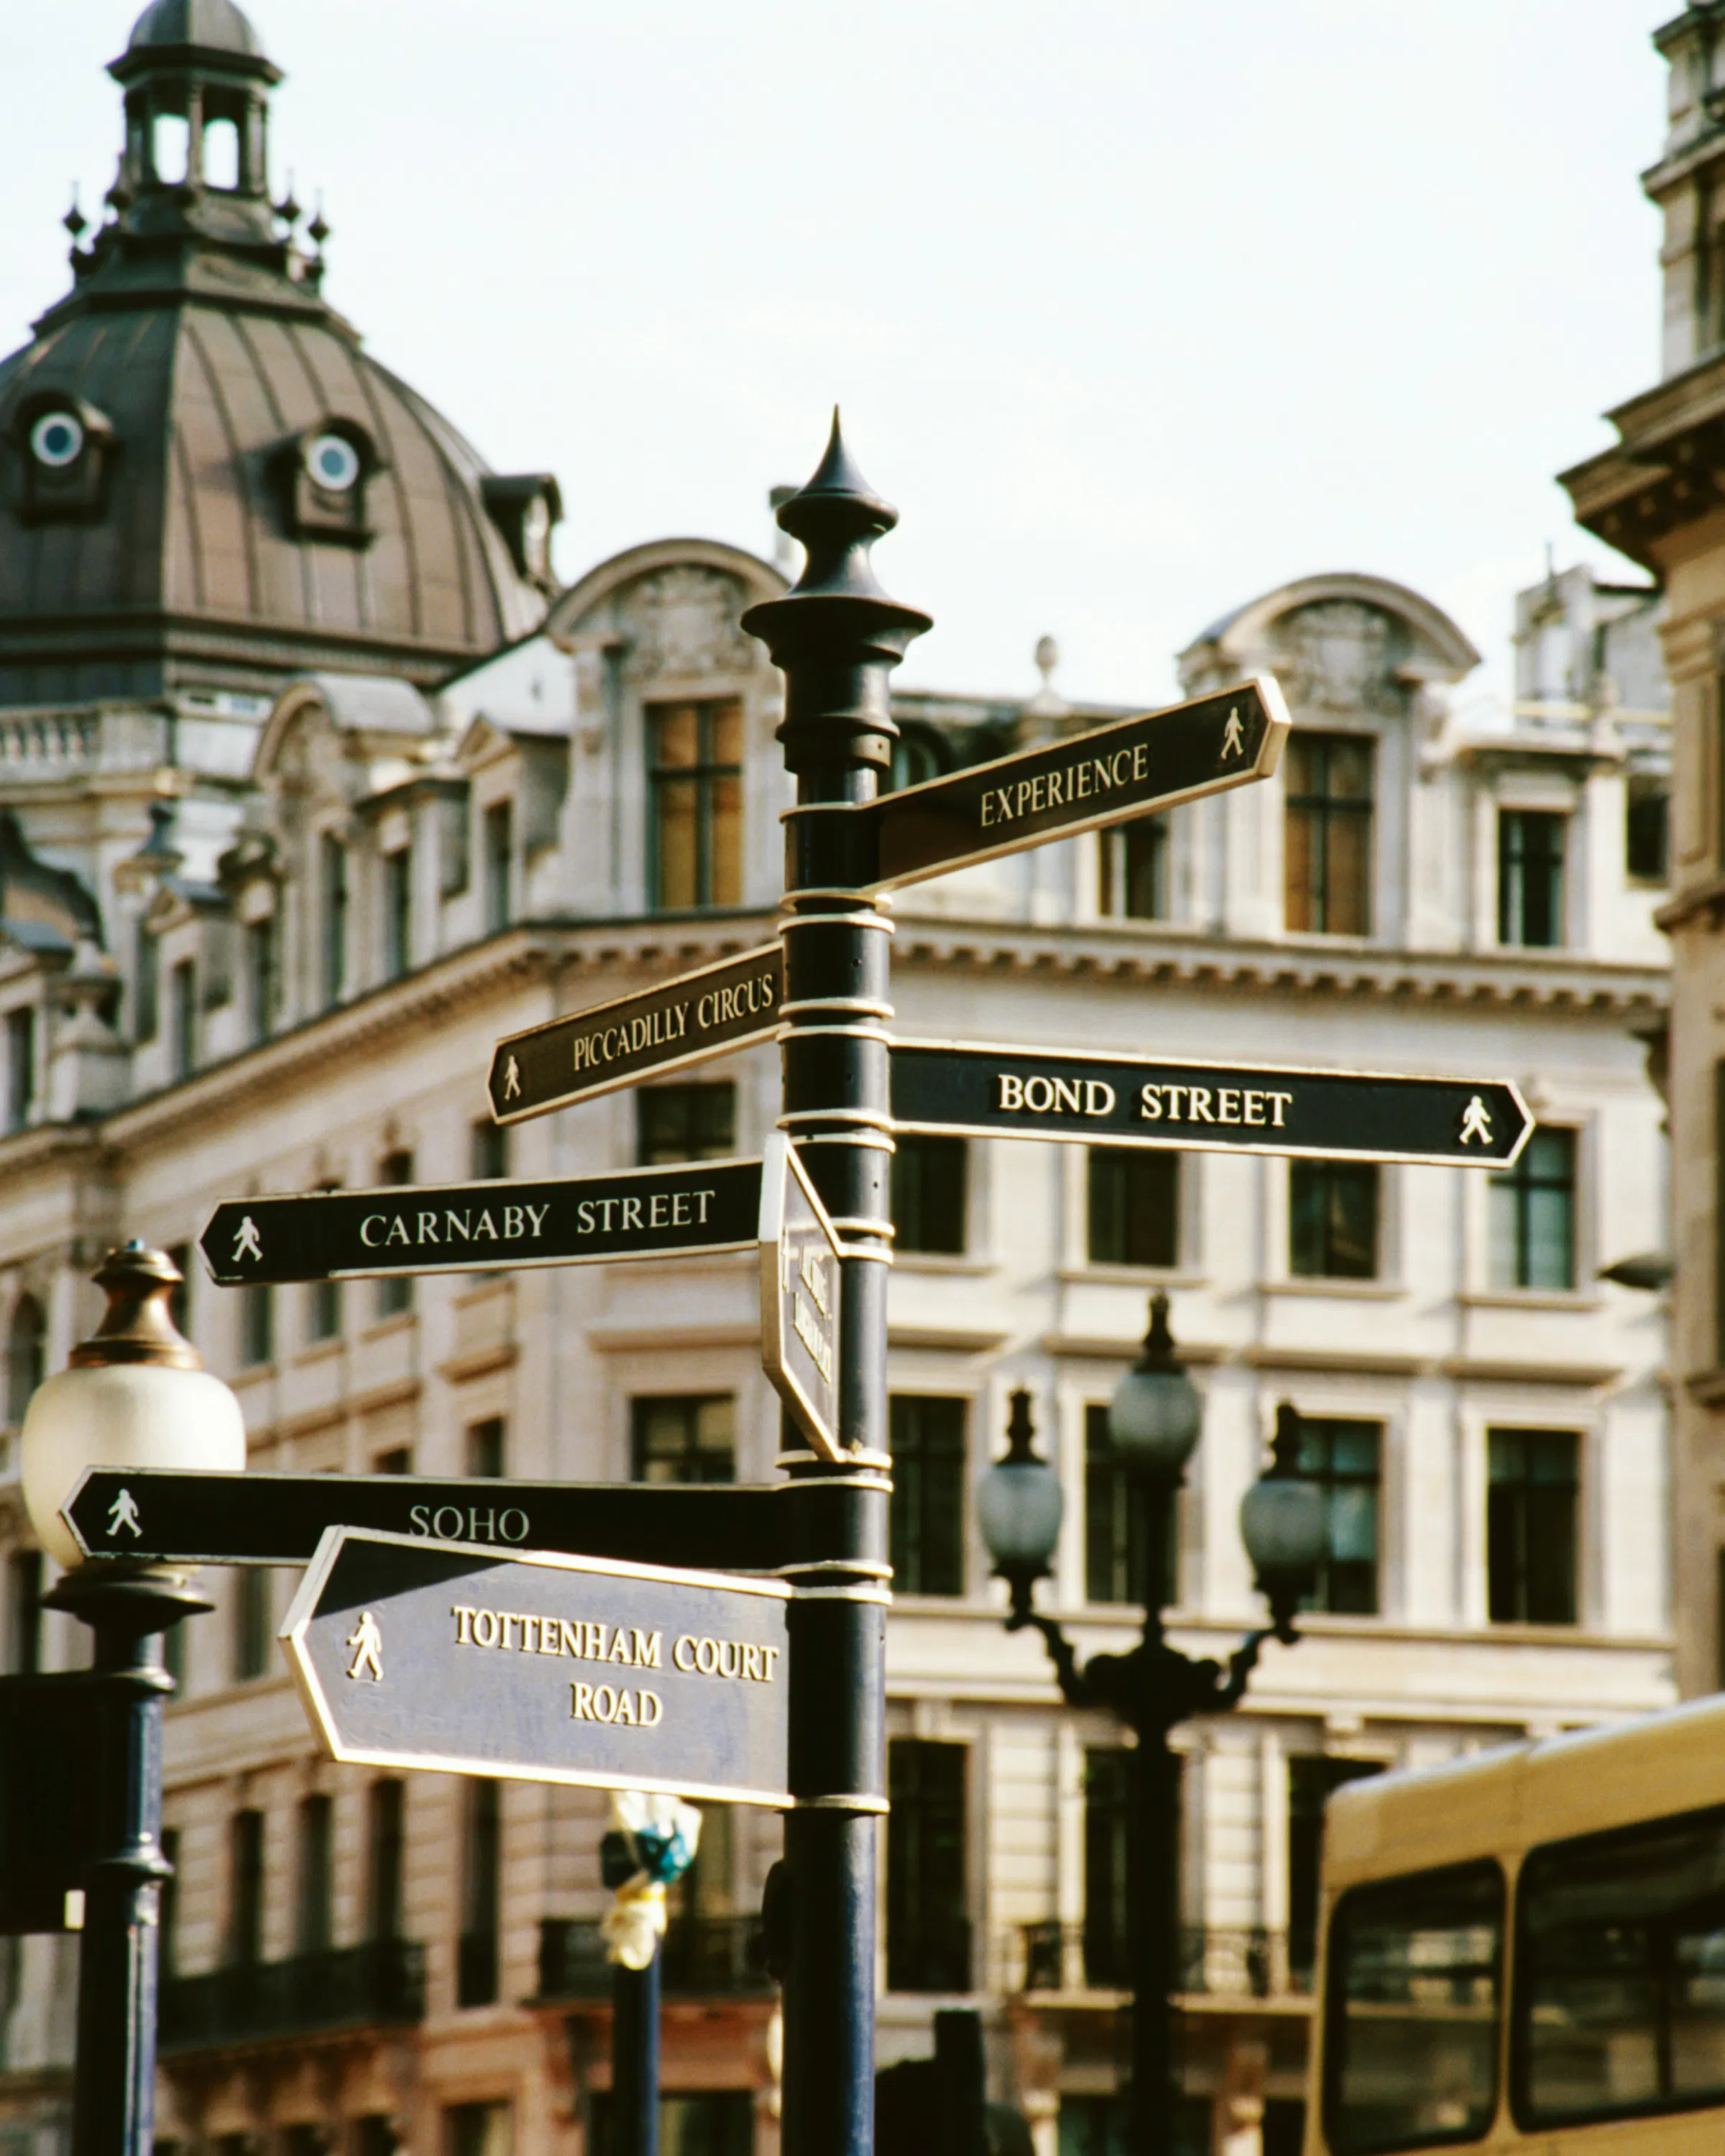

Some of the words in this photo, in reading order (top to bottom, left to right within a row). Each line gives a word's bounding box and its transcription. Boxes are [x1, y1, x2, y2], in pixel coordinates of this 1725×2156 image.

[980, 743, 1149, 827] EXPERIENCE
[574, 1001, 689, 1071] PICCADILLY
[698, 973, 773, 1029] CIRCUS
[998, 1074, 1116, 1116] BOND
[1141, 1084, 1293, 1127] STREET
[360, 1204, 551, 1248] CARNABY
[576, 1190, 716, 1234] STREET
[409, 1504, 530, 1542] SOHO
[452, 1606, 663, 1669] TOTTENHAM
[673, 1634, 780, 1682] COURT
[571, 1682, 663, 1727] ROAD
